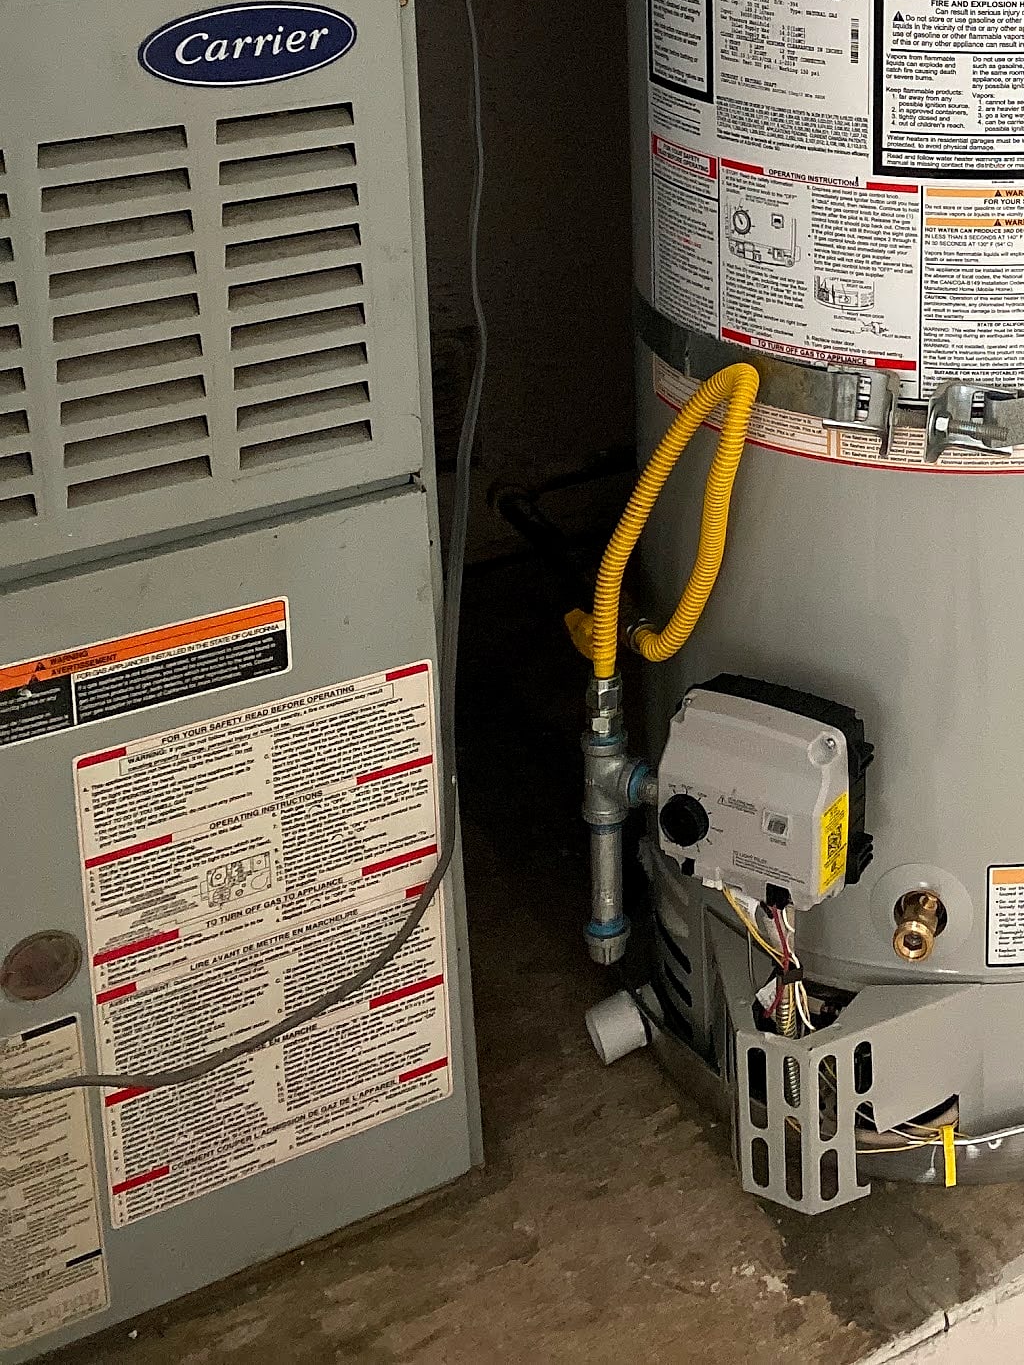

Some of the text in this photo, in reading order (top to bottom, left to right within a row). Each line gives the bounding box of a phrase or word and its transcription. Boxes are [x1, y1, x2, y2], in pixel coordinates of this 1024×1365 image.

[1002, 8, 1019, 17] injury
[968, 16, 995, 25] gasoline
[892, 23, 912, 31] liquids
[933, 24, 955, 32] vicinity
[913, 31, 940, 40] gasoline
[175, 25, 329, 65] Carrier
[952, 40, 983, 49] appliance
[768, 169, 806, 180] OPERATING
[767, 342, 784, 351] TURN
[785, 346, 797, 354] OFF
[799, 349, 814, 357] GAS
[827, 354, 867, 364] APPLIANCE
[162, 685, 355, 743] FOR YOUR SAFETY READ BEFORE OPERATING
[209, 791, 324, 829] OPERATING INSTRUCTIONS
[220, 910, 242, 922] TURN
[244, 904, 260, 914] OFF
[263, 897, 281, 908] GAS
[297, 878, 343, 897] APPLIANCE
